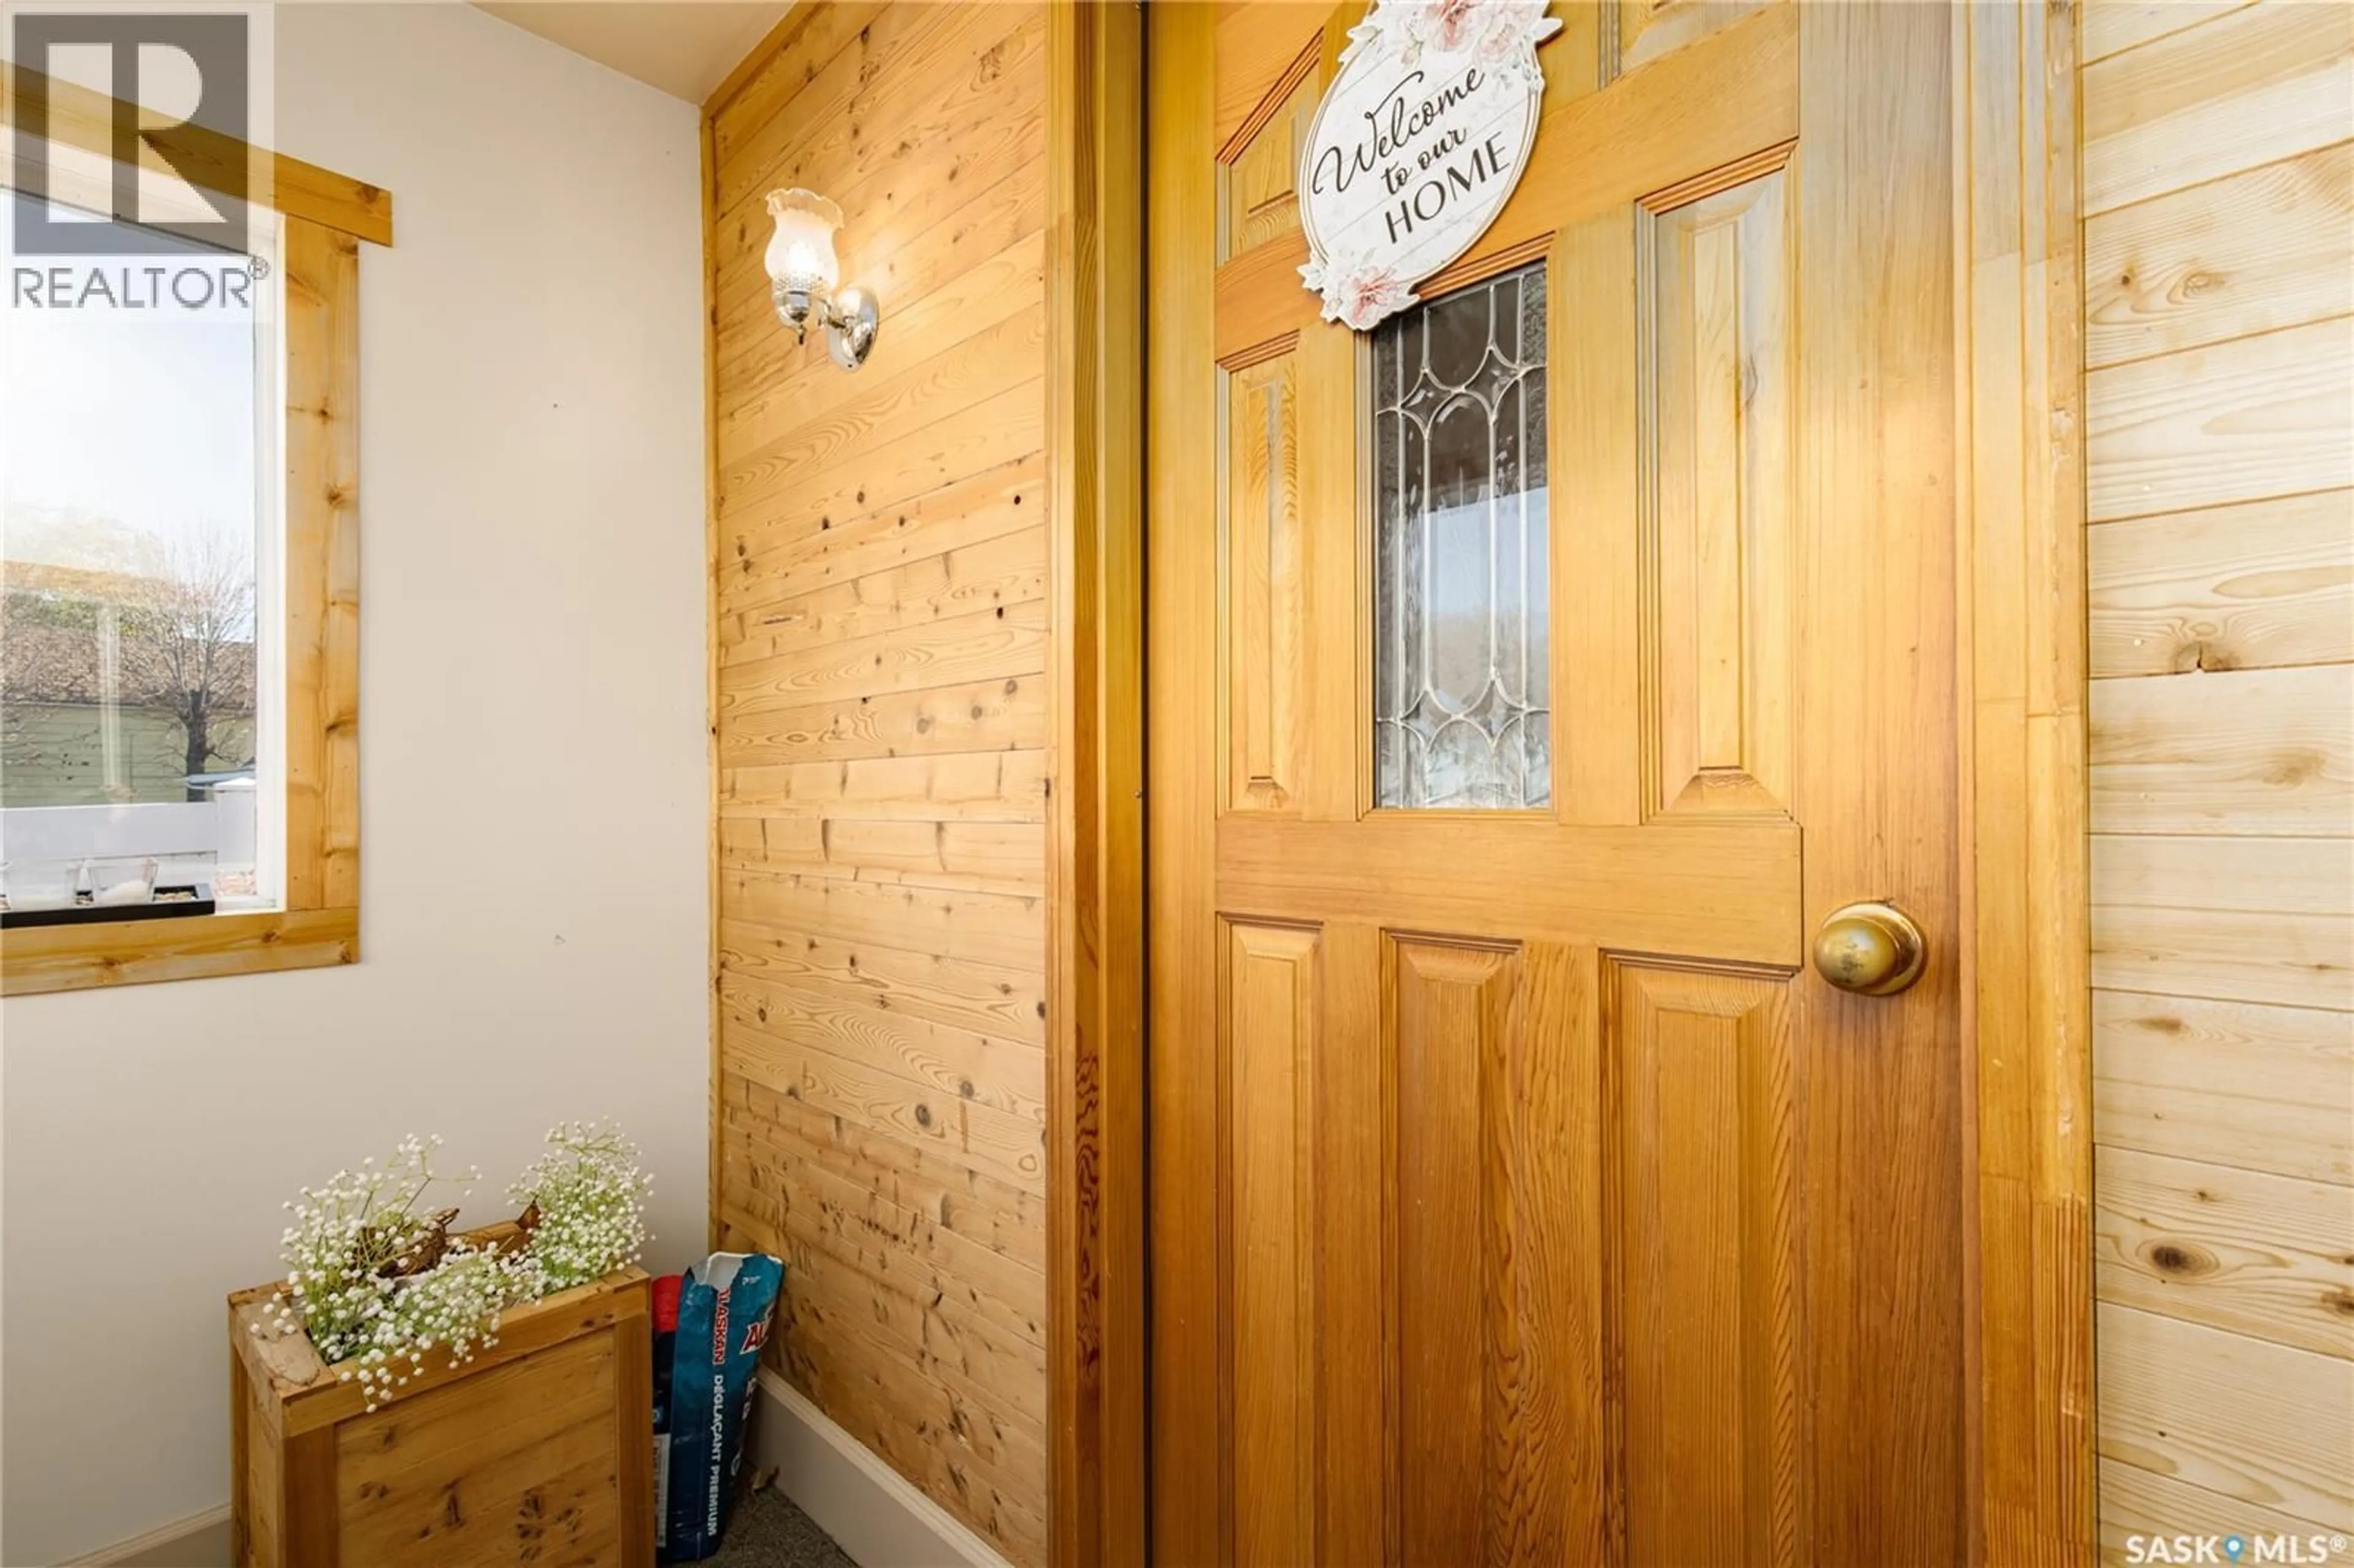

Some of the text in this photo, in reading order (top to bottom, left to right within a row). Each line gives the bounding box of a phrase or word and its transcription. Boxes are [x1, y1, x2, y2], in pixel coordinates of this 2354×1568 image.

[1312, 68, 1486, 194] Welcome
[1380, 126, 1467, 196] to our
[1384, 130, 1511, 245] HOME
[707, 1464, 720, 1537] PREMIUM
